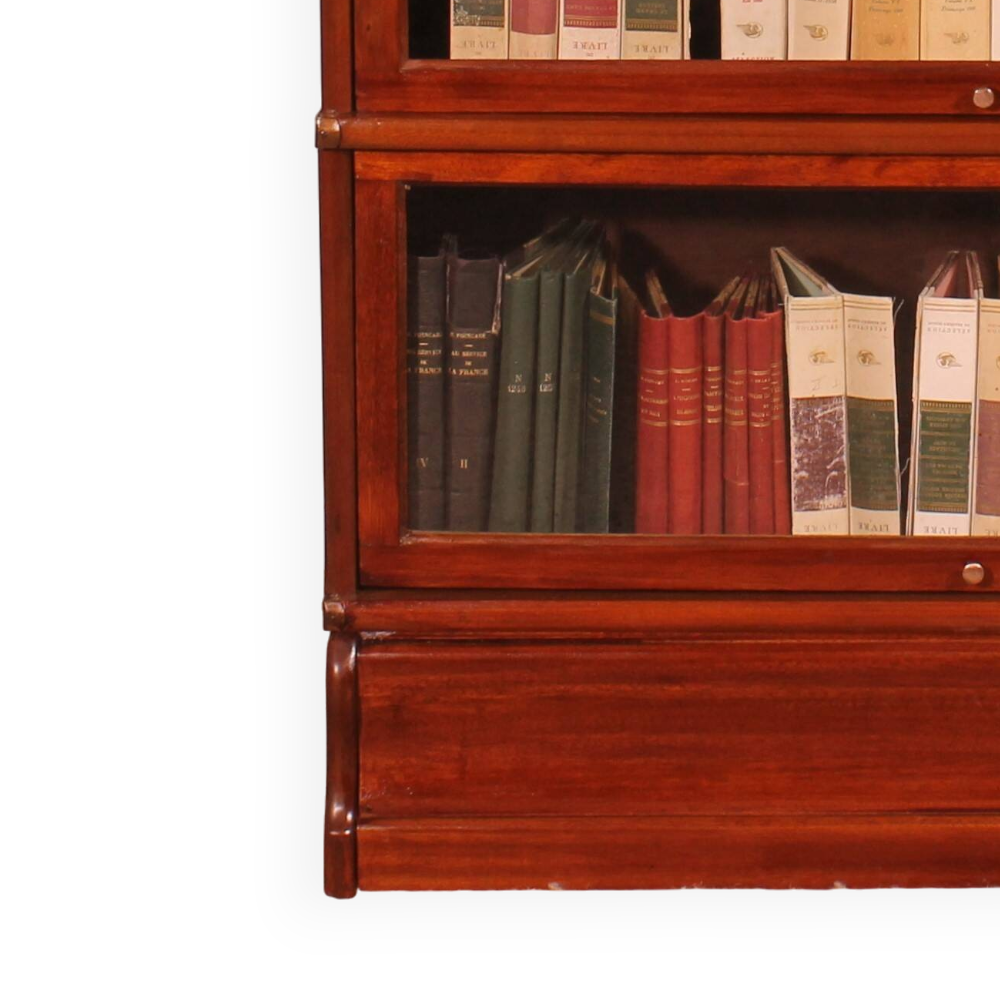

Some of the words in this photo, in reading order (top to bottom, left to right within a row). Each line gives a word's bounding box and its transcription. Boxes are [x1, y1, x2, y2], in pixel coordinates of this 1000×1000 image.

[572, 41, 607, 50] LIVRE
[858, 522, 889, 531] LIVRE
[923, 526, 958, 535] LIVRE
